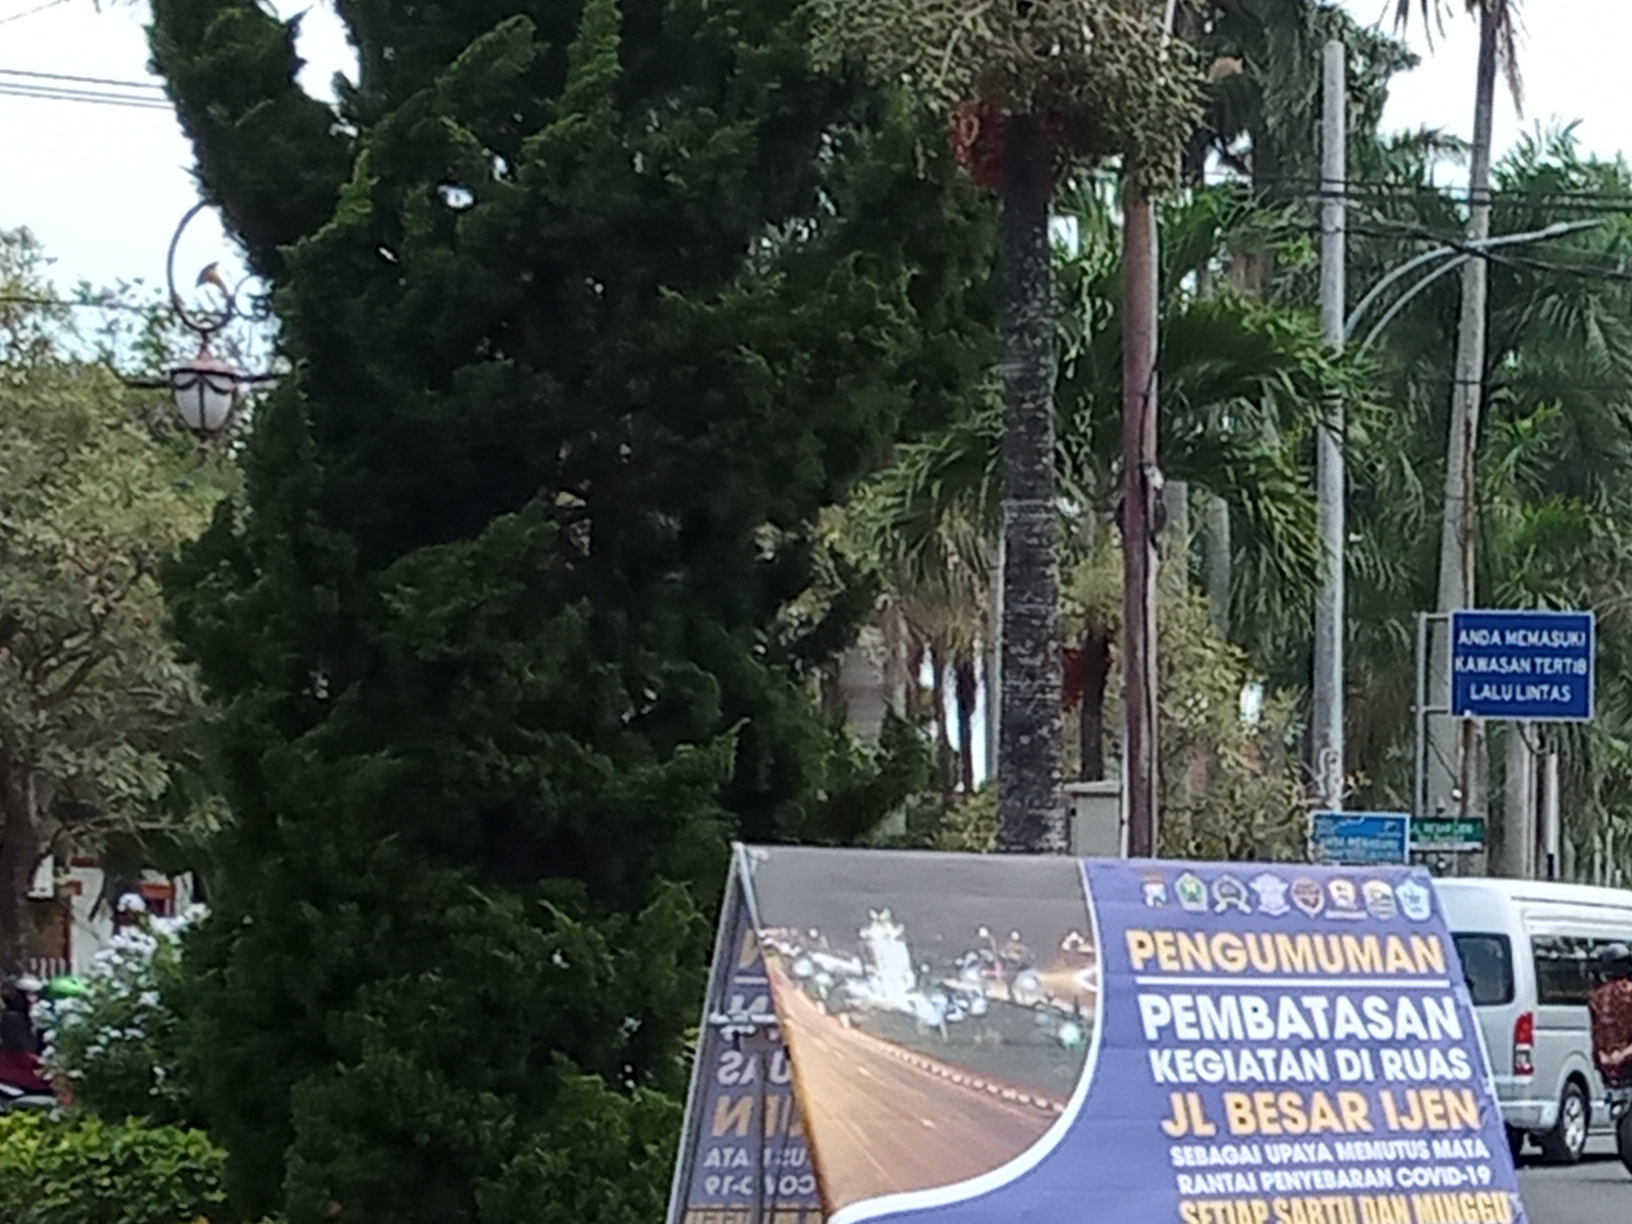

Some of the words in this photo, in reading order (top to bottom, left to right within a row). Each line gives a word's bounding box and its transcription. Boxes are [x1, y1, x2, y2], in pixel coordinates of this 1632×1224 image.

[1458, 629, 1502, 646] ANDA
[1505, 630, 1587, 648] MEMASUKI
[1455, 656, 1531, 673] KAWASAN
[1534, 657, 1587, 675] TERTIB
[1470, 683, 1513, 702] LALU
[1516, 684, 1571, 702] LINTAS
[1125, 929, 1447, 974] PENGUMUMAN
[1137, 994, 1464, 1041] PEMBATASAN
[1149, 1047, 1331, 1083] KEGIATAN
[1335, 1047, 1373, 1081] DI
[1379, 1047, 1472, 1082] RUAS
[1160, 1091, 1217, 1137] JL
[1223, 1089, 1374, 1135] BESAR
[1379, 1088, 1482, 1132] IJEN
[1170, 1144, 1263, 1167] SEBAGAI
[1265, 1142, 1335, 1165] UPAYA
[1336, 1140, 1431, 1162] MEMUTUS
[1432, 1138, 1491, 1160] MATA
[1177, 1172, 1259, 1195] RANTAI
[1262, 1169, 1394, 1192] PENYEBARAN
[1396, 1165, 1492, 1188] COVID-19
